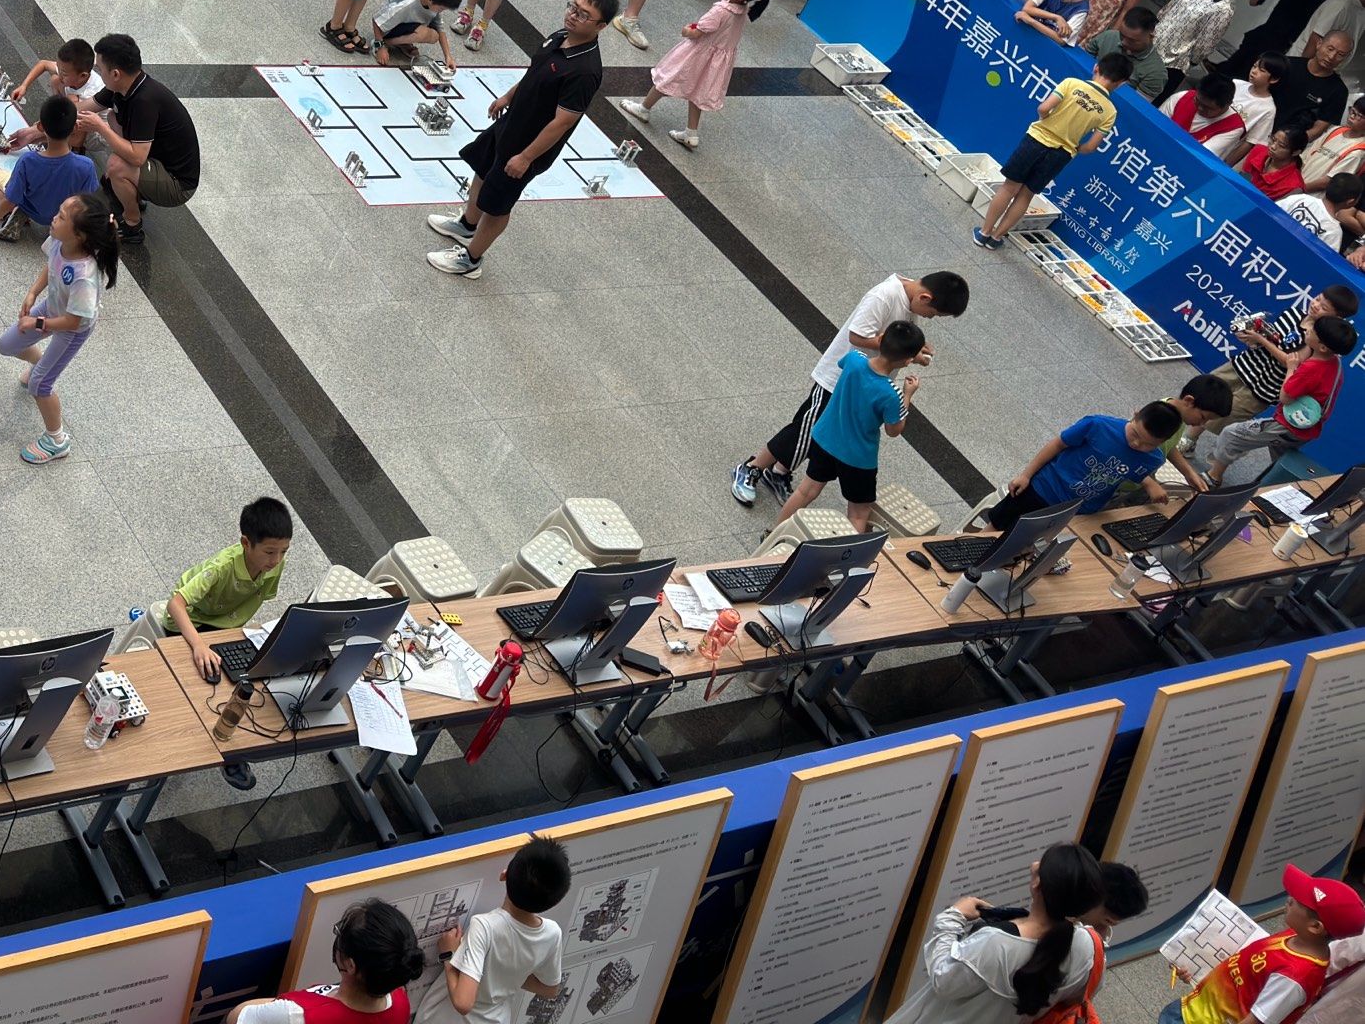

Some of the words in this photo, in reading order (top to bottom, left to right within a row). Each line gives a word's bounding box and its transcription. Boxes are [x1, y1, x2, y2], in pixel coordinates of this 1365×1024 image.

[1086, 236, 1130, 275] LIBRARY
[1133, 217, 1174, 256] 嘉兴
[1172, 299, 1237, 362] Abilix
